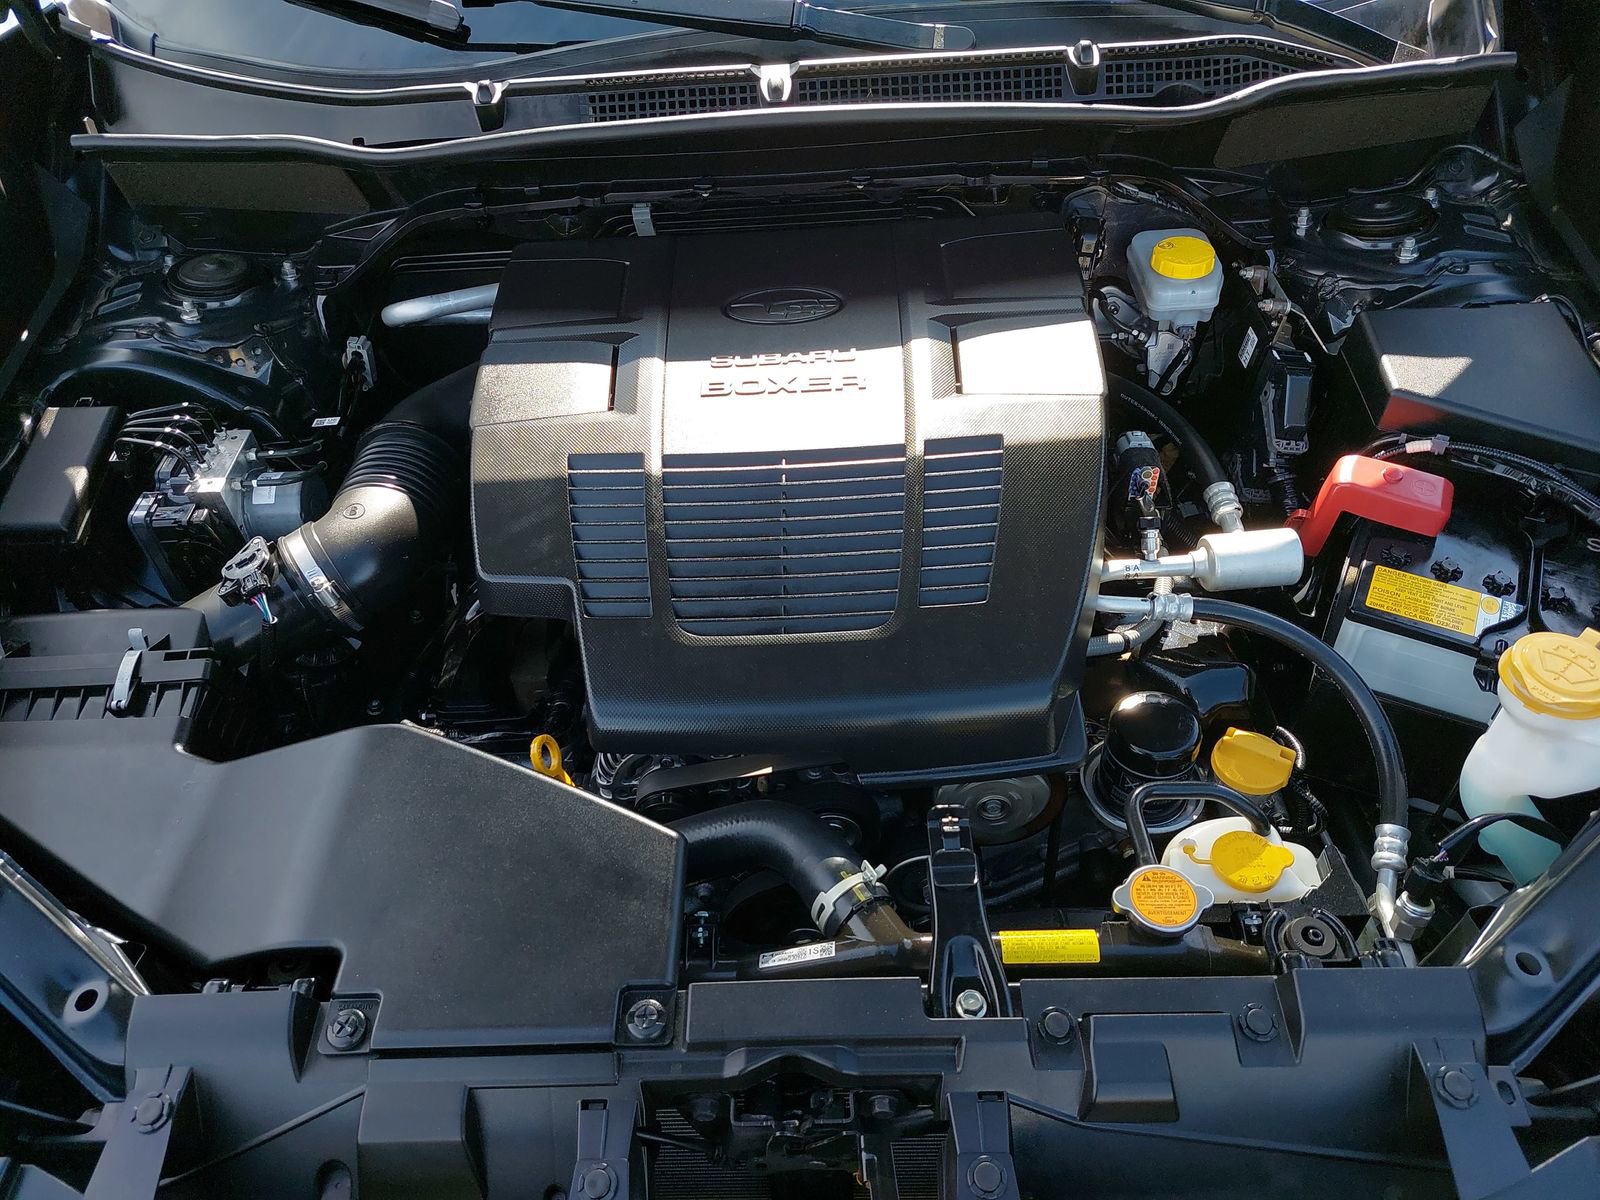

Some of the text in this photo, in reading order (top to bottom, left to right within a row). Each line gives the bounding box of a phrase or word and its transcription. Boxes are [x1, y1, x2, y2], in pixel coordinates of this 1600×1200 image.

[710, 348, 856, 368] SUBARU
[700, 376, 867, 398] BOXER
[1377, 566, 1407, 578] DANGER
[1371, 586, 1401, 597] POISON
[1403, 610, 1418, 618] CCA
